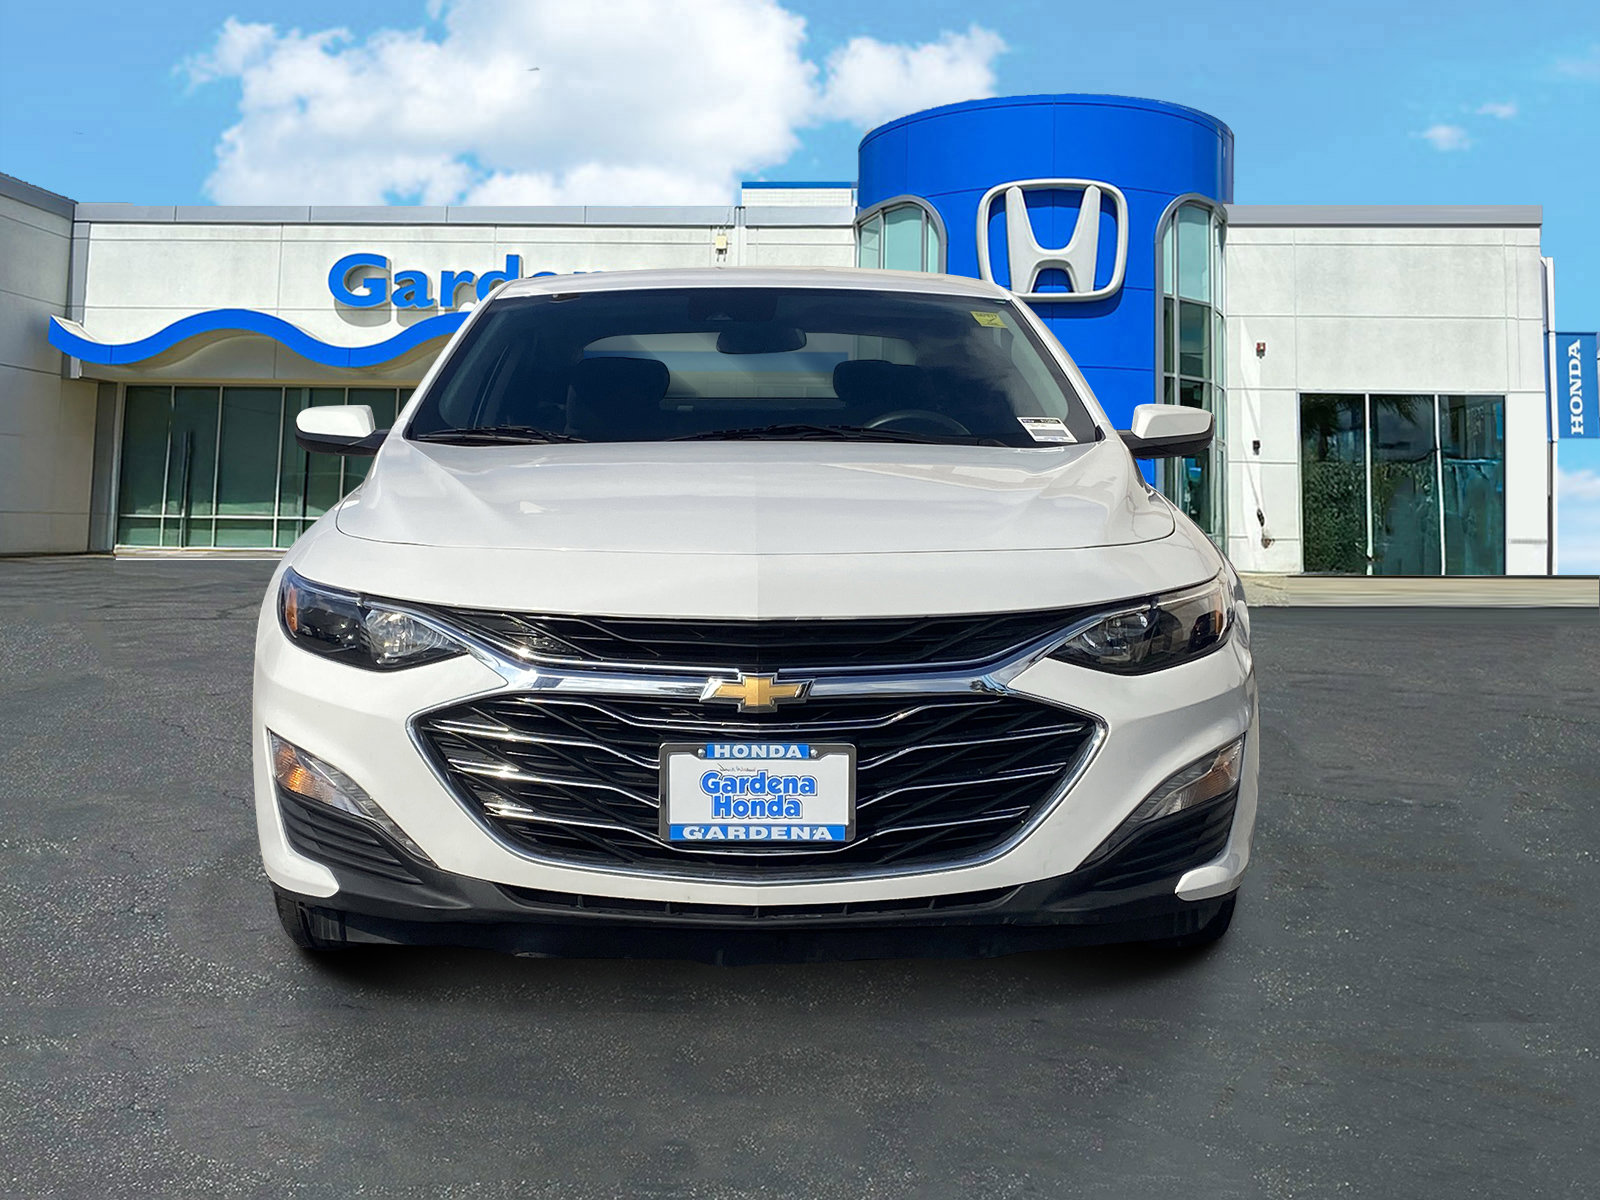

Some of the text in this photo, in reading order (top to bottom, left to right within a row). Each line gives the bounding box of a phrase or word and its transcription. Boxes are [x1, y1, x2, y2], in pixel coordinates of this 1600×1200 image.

[328, 253, 606, 308] Gard
[1568, 339, 1584, 435] HONDA
[714, 744, 802, 758] HONDA
[701, 771, 817, 795] Gardena
[713, 795, 802, 817] Honda
[682, 826, 832, 840] GARDENA
